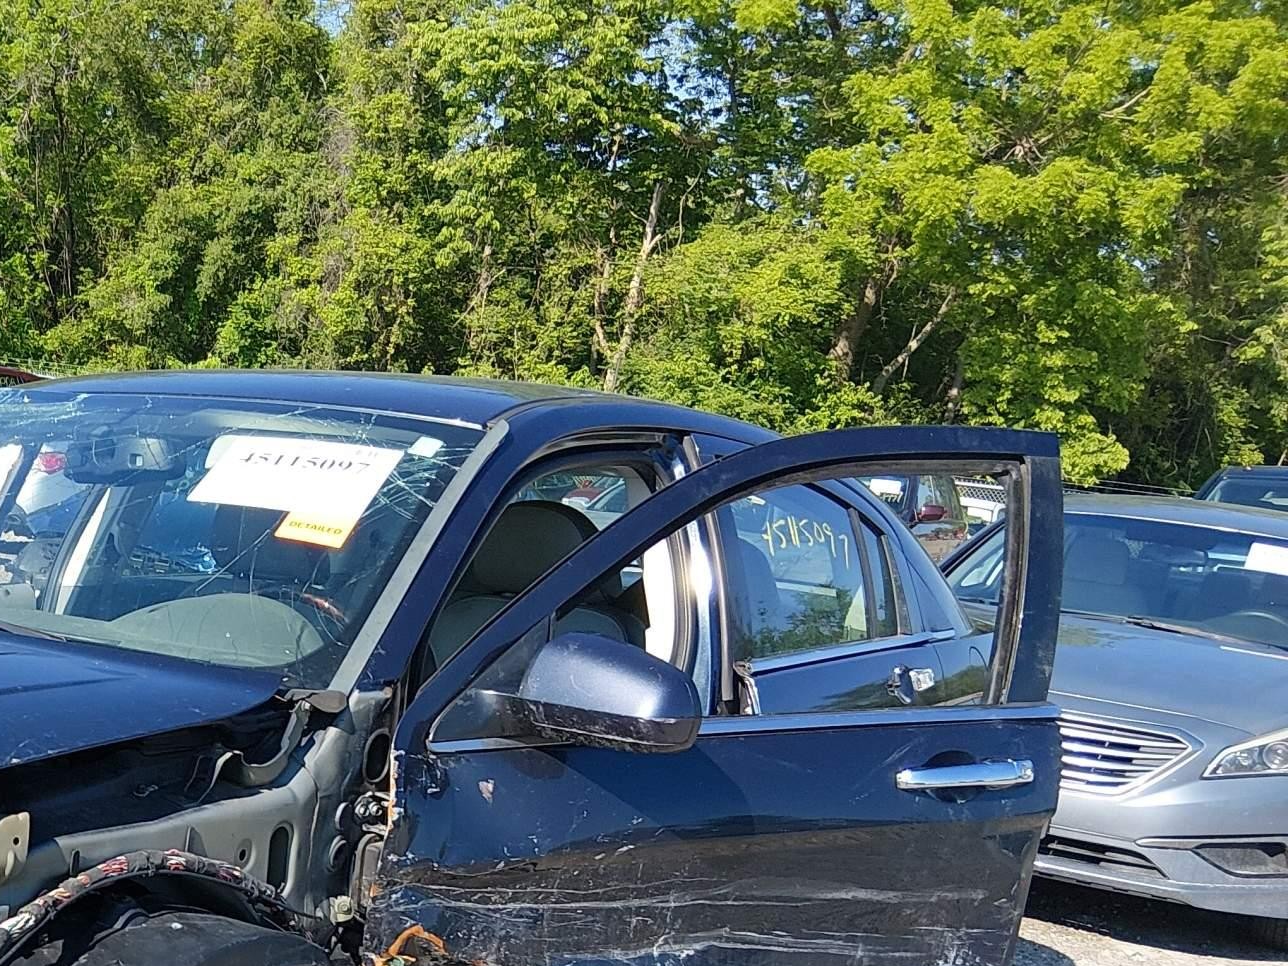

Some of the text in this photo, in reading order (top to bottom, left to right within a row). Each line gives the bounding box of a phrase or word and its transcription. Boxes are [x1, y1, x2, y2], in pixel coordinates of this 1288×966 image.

[239, 451, 372, 474] 45115097
[288, 519, 343, 536] DETAILED
[761, 515, 849, 569] 45115097
